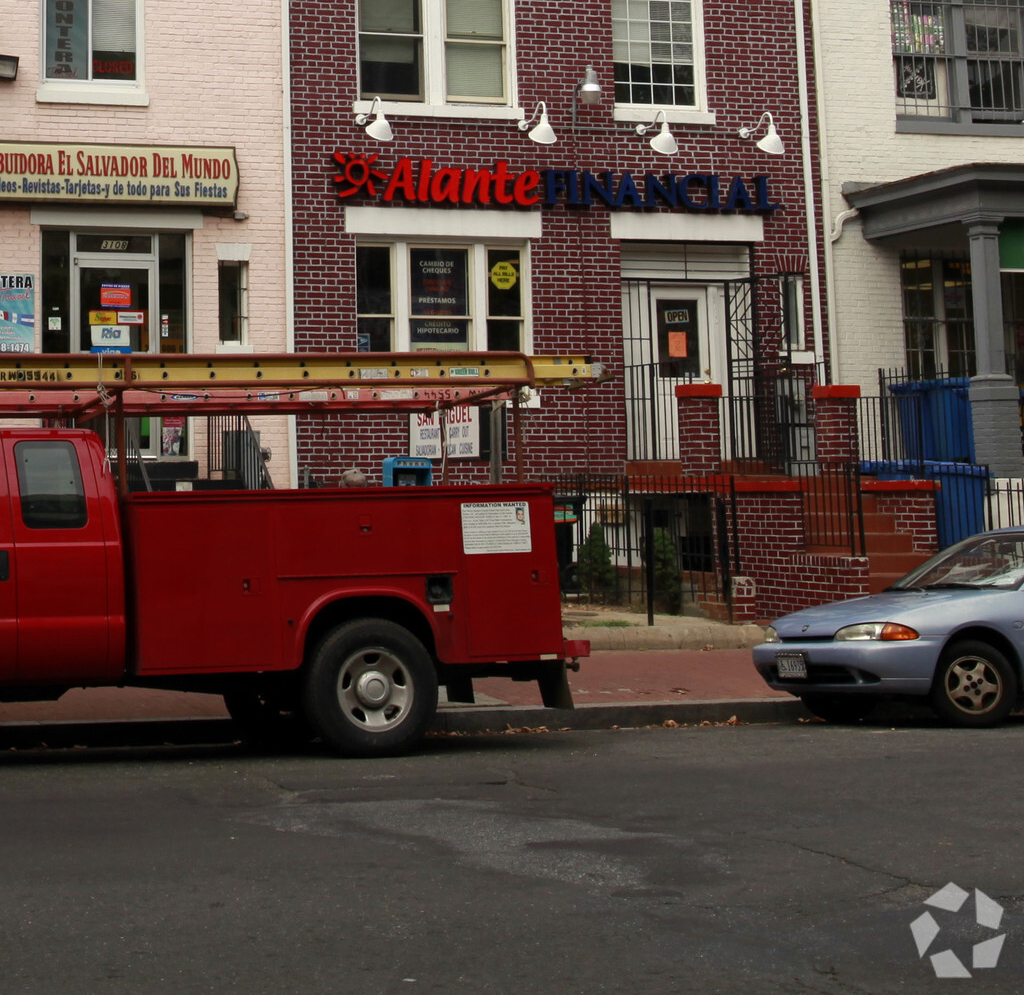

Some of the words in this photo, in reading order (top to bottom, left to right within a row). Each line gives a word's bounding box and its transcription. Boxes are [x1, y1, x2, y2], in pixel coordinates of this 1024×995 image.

[93, 60, 134, 75] CLOSED
[112, 180, 124, 195] de
[127, 181, 147, 196] todo
[149, 183, 170, 200] para
[174, 181, 191, 197] Sus
[194, 182, 228, 198] Fiestas
[382, 158, 541, 206] Alante
[540, 169, 780, 211] FINANCIAL
[101, 240, 128, 250] 3108
[667, 310, 688, 322] OPEN
[101, 328, 121, 339] Ria
[417, 412, 434, 426] SAN
[449, 426, 460, 439] CARRY
[462, 425, 470, 438] OUT
